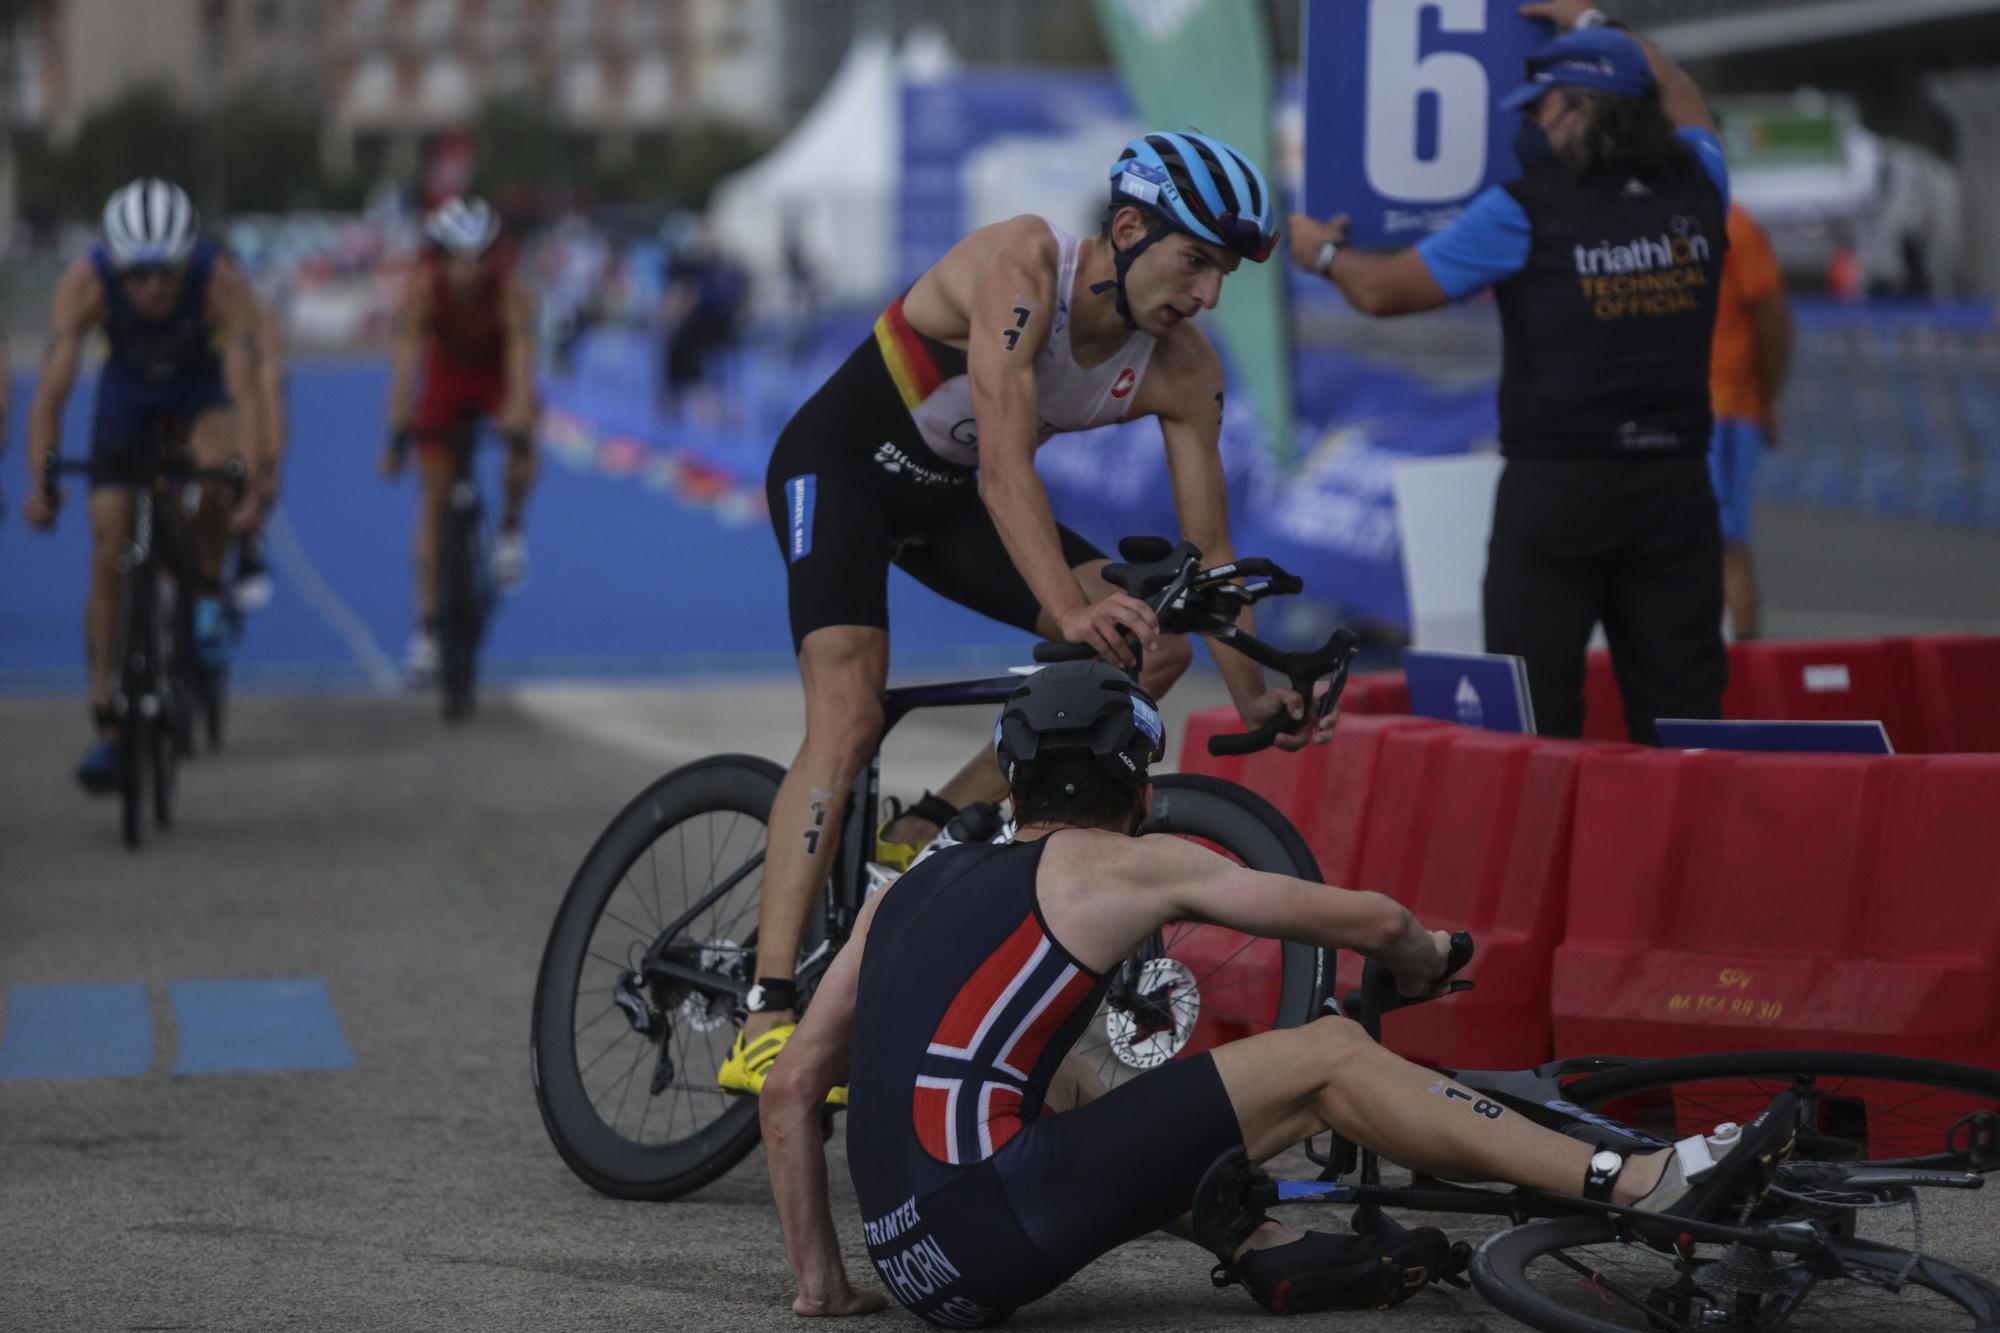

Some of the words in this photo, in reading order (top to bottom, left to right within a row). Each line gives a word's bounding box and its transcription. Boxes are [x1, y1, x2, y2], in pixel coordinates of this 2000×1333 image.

[1364, 0, 1489, 204] 6
[1574, 232, 1709, 276] triathlon
[1579, 268, 1706, 300] TECHNICAL
[1594, 291, 1698, 320] OFFICIAL
[1444, 1086, 1504, 1120] 18
[863, 1194, 921, 1246] TRIMTEX
[877, 1234, 962, 1304] THORN
